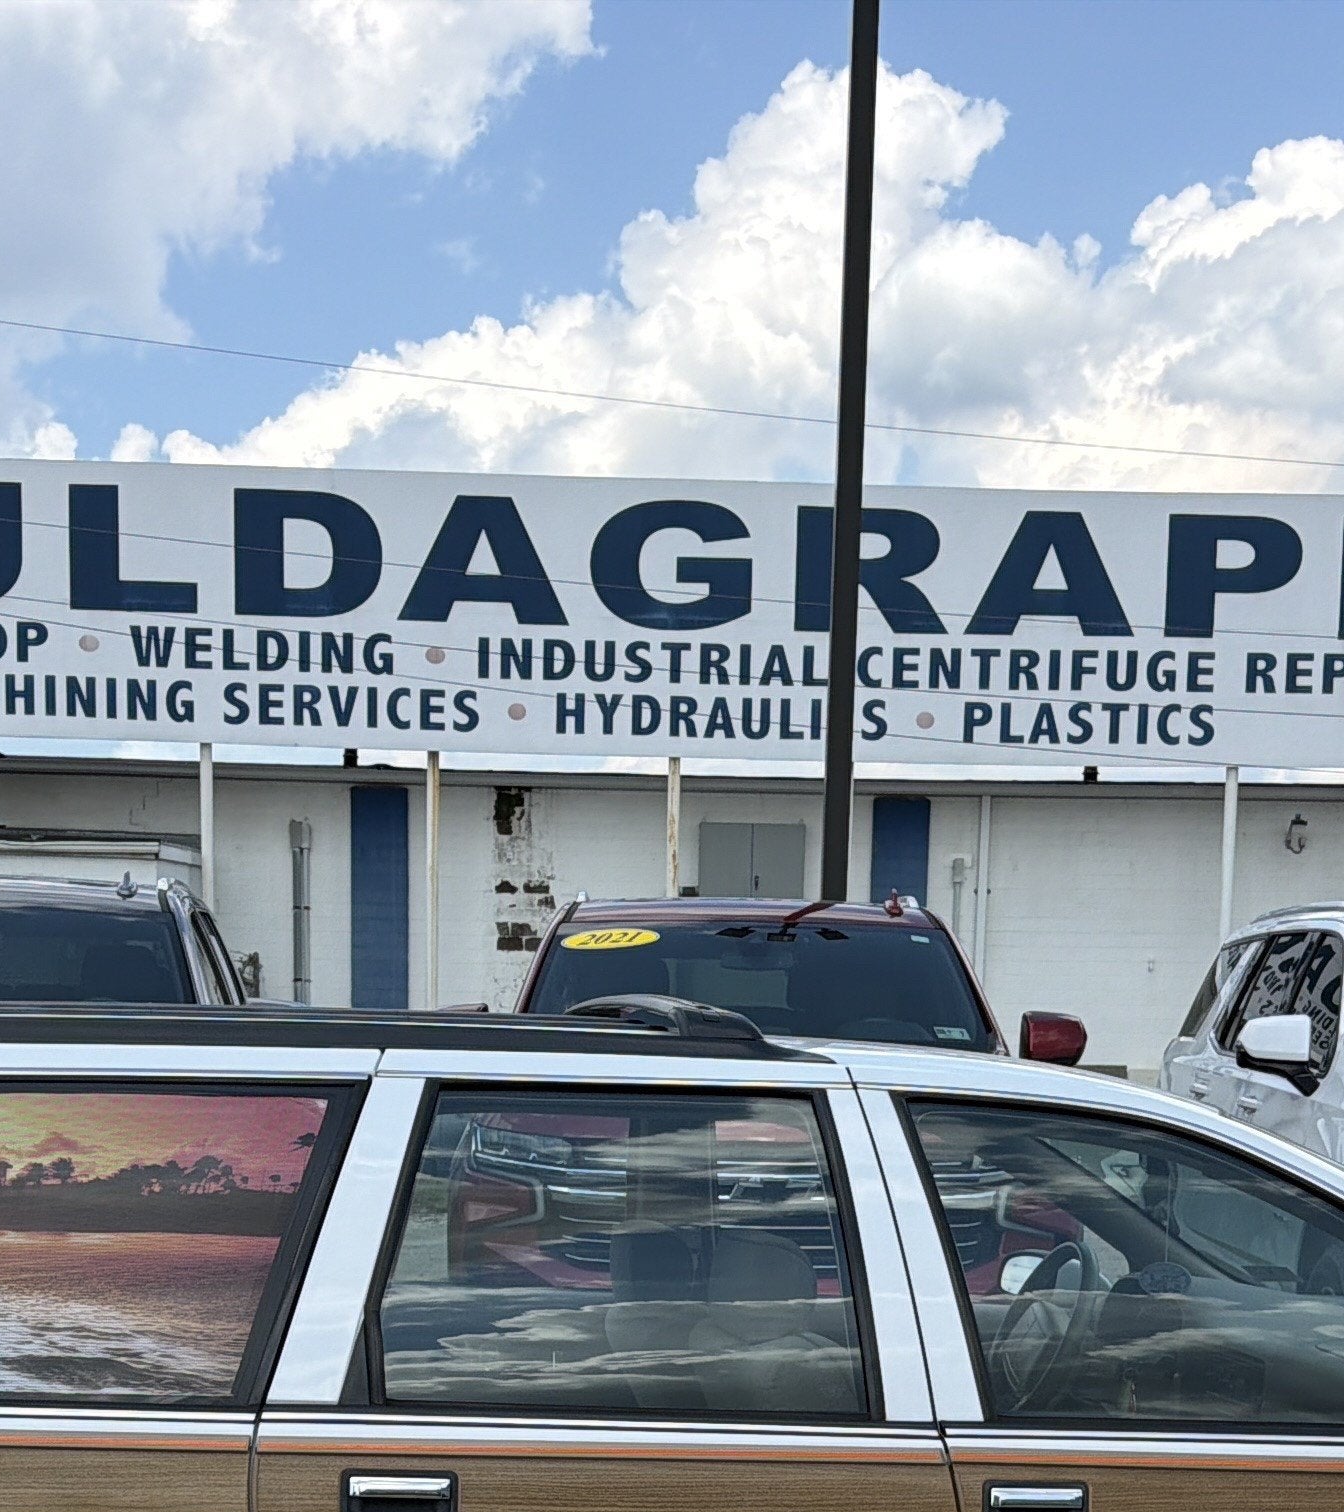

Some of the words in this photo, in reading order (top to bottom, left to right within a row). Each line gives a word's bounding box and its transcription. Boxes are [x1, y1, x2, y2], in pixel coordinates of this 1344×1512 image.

[129, 624, 396, 676] WELDING
[477, 636, 829, 688] INDUSTRIAL
[857, 645, 1217, 694] CENTRIFUGE
[223, 682, 481, 734] SERVICES
[556, 691, 888, 741] HYDRAULIS
[962, 700, 1217, 747] PLASTICS
[576, 931, 644, 946] 2021
